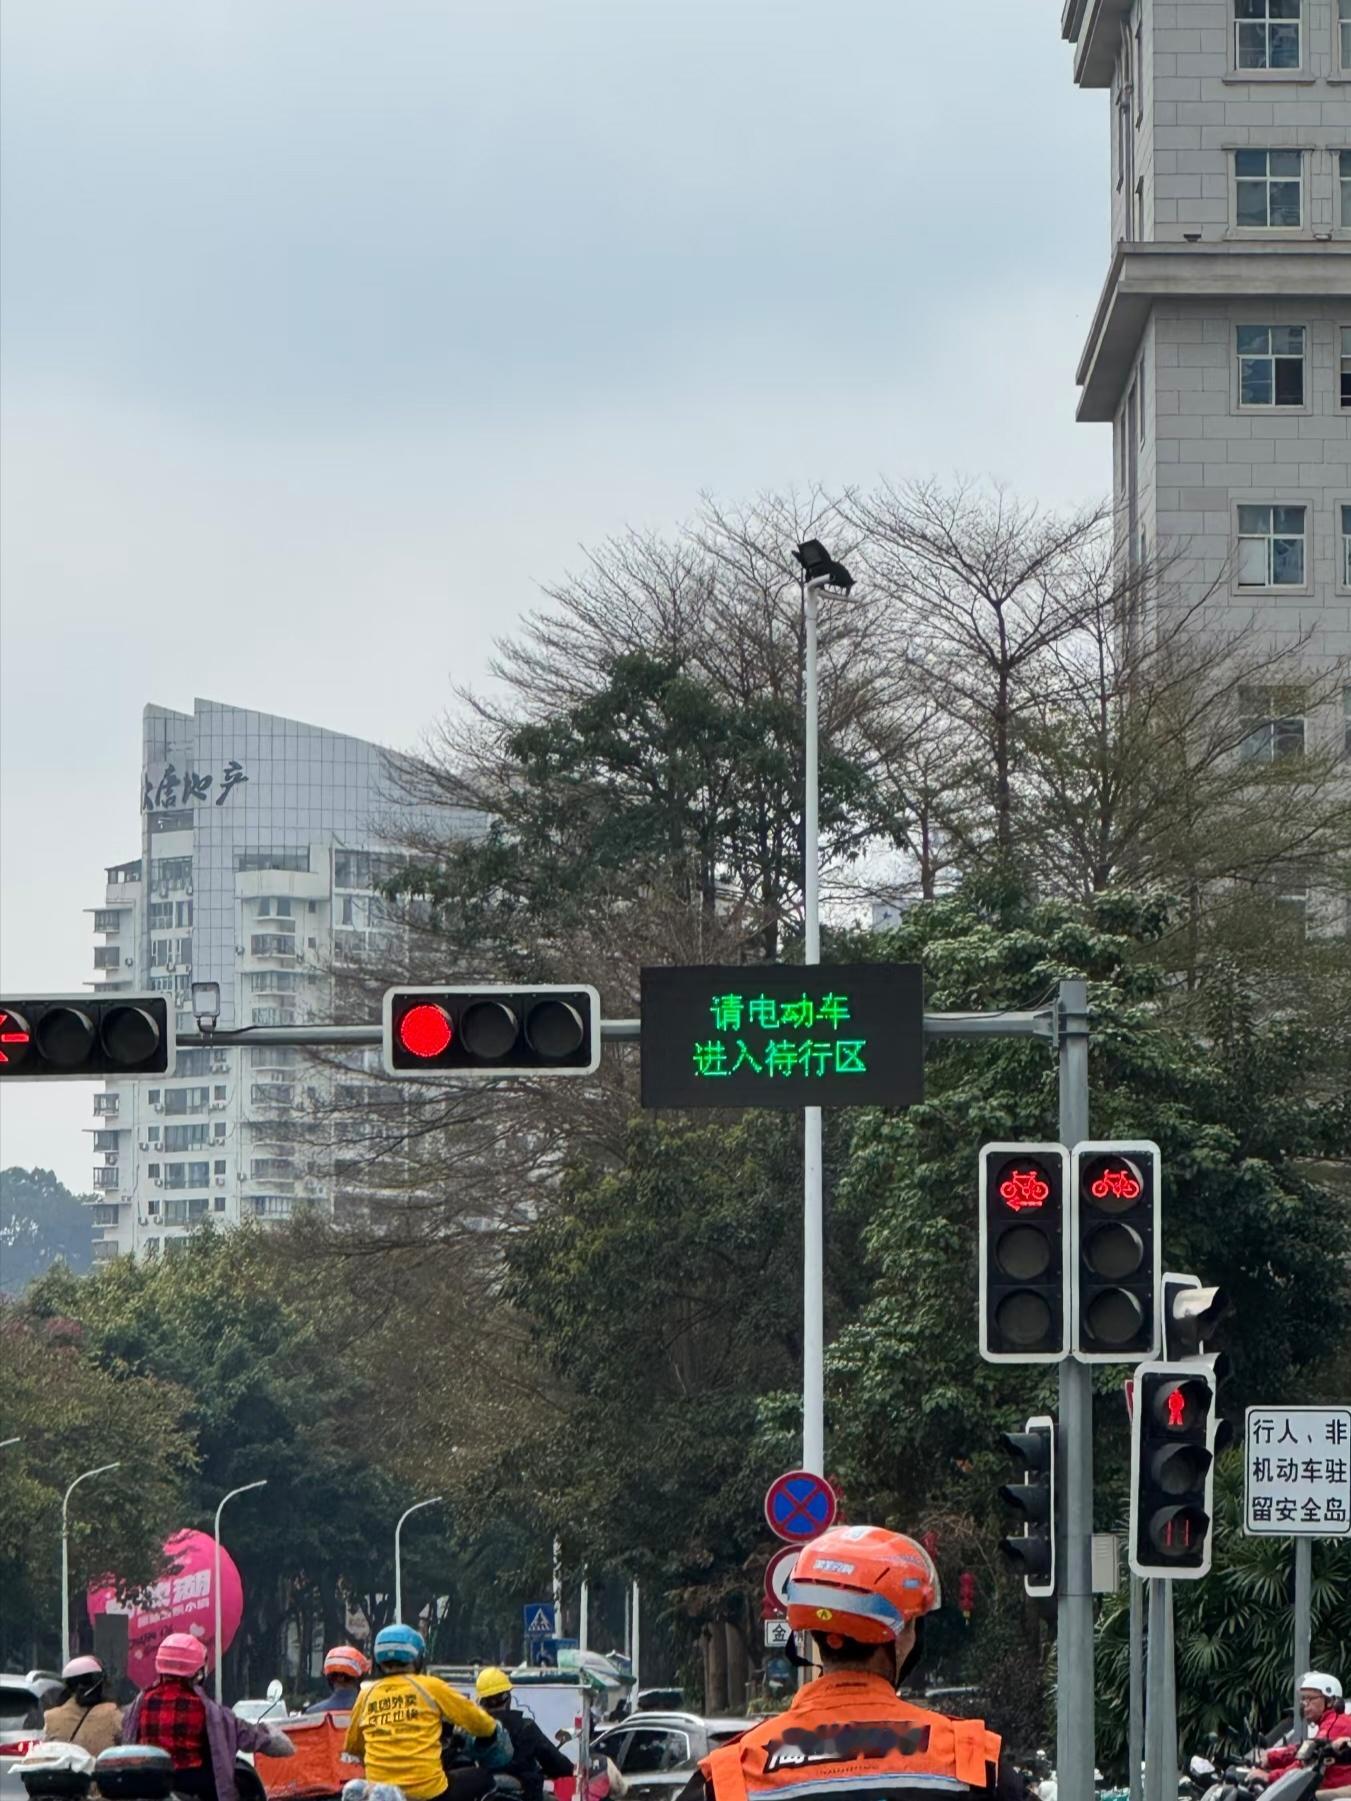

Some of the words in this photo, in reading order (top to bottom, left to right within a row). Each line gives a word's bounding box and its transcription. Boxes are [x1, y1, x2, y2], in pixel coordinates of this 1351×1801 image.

[710, 992, 850, 1031] 请电动车
[693, 1039, 867, 1077] 进入待行区
[1253, 1418, 1347, 1444] 行人、非
[1253, 1457, 1347, 1484] 机动车驻
[1252, 1496, 1346, 1523] 留安全岛
